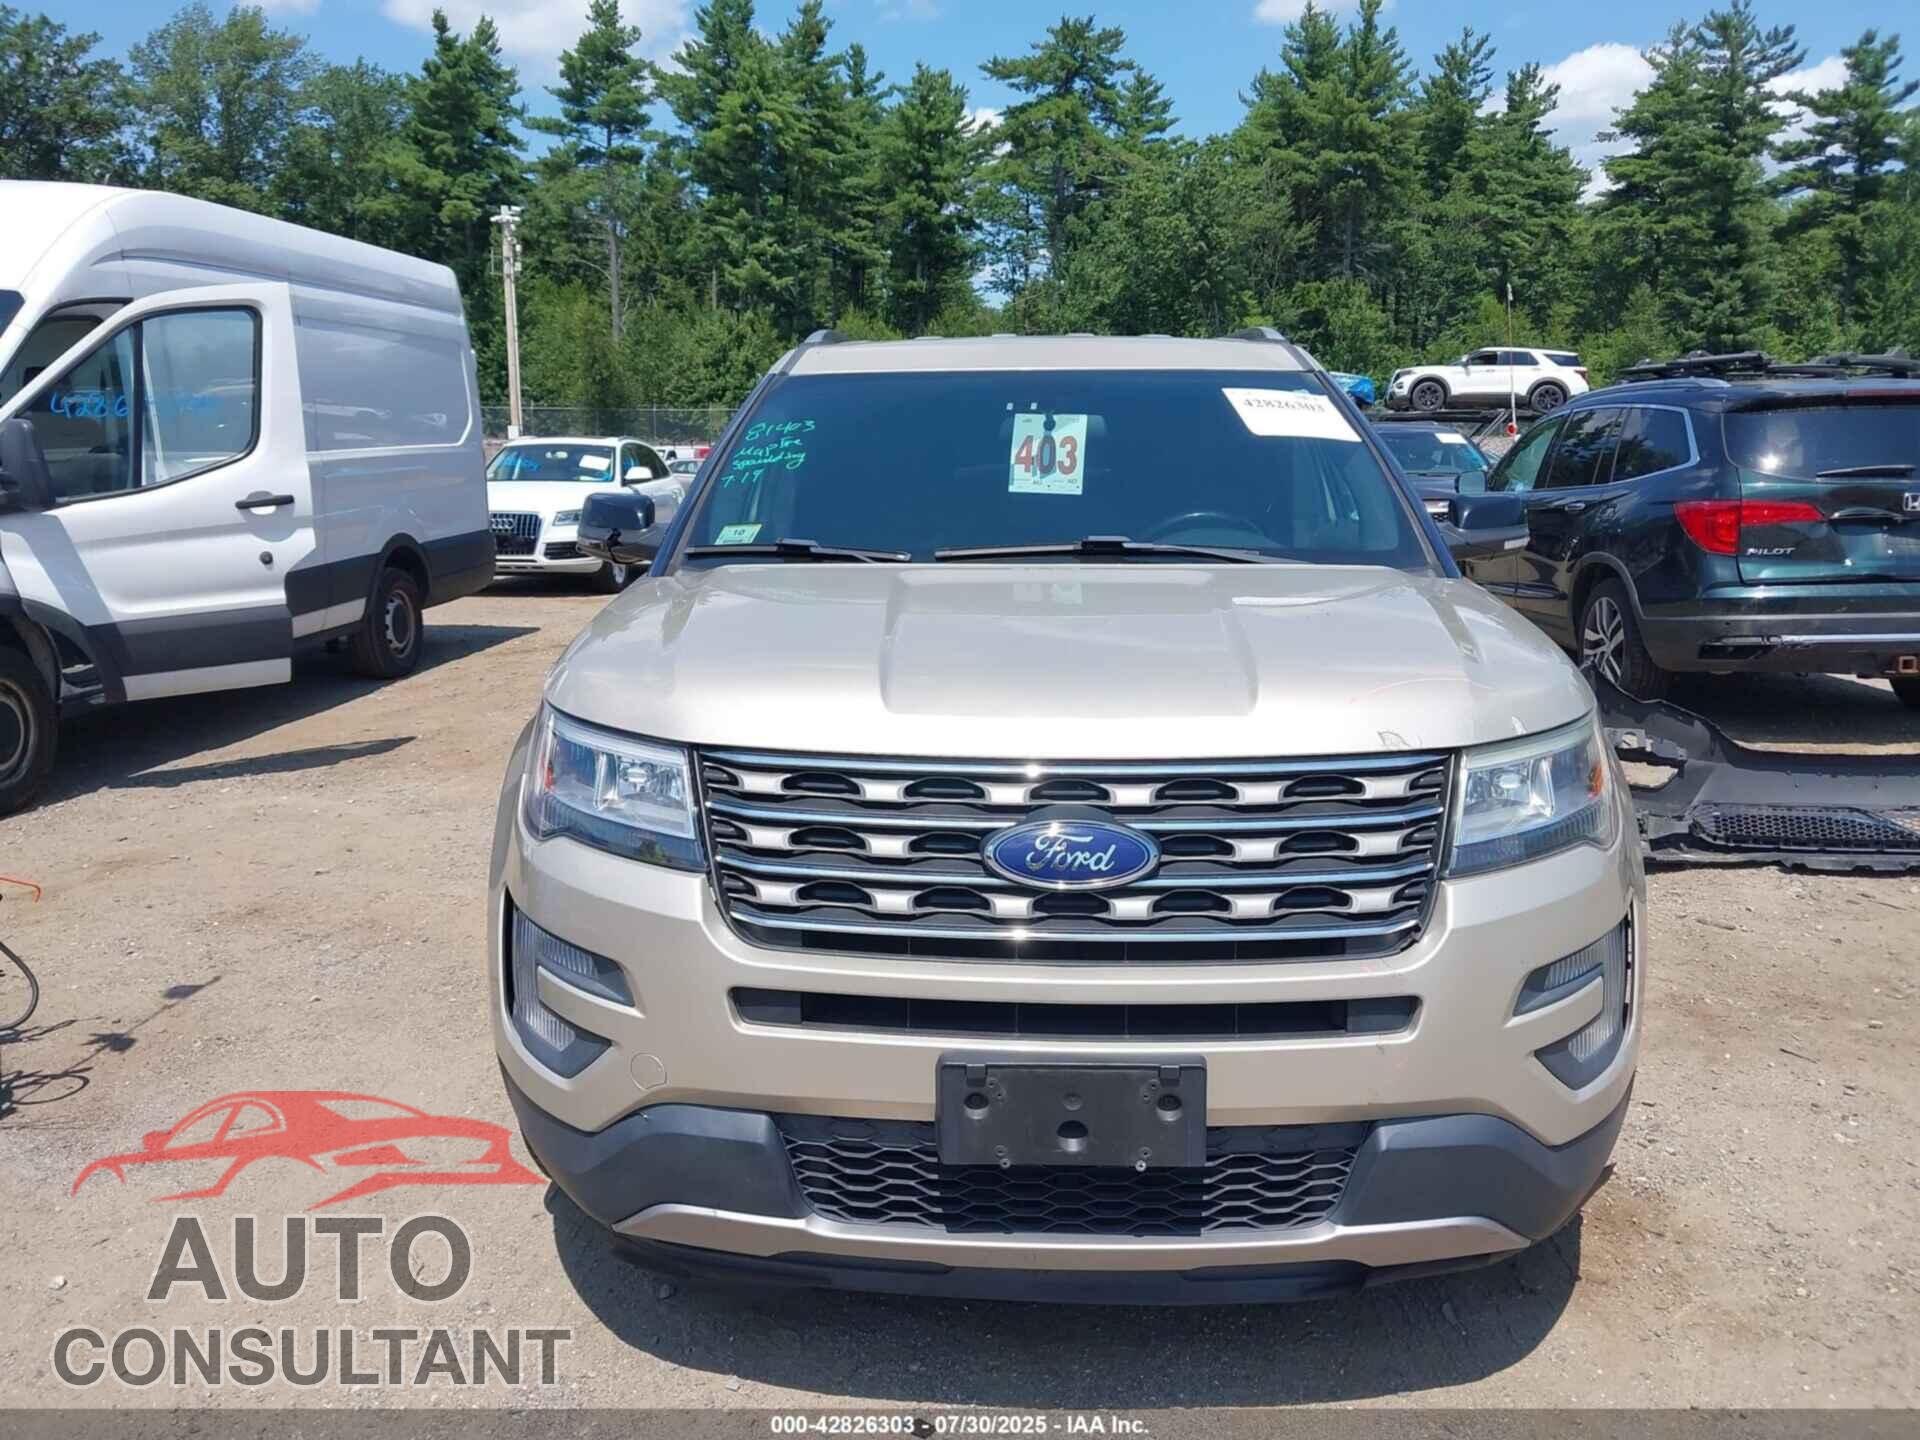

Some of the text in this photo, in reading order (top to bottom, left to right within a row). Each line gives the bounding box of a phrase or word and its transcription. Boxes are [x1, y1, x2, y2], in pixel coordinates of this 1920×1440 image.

[1014, 434, 1078, 475] 403
[1746, 547, 1796, 556] PILOT
[1026, 832, 1117, 872] Ford
